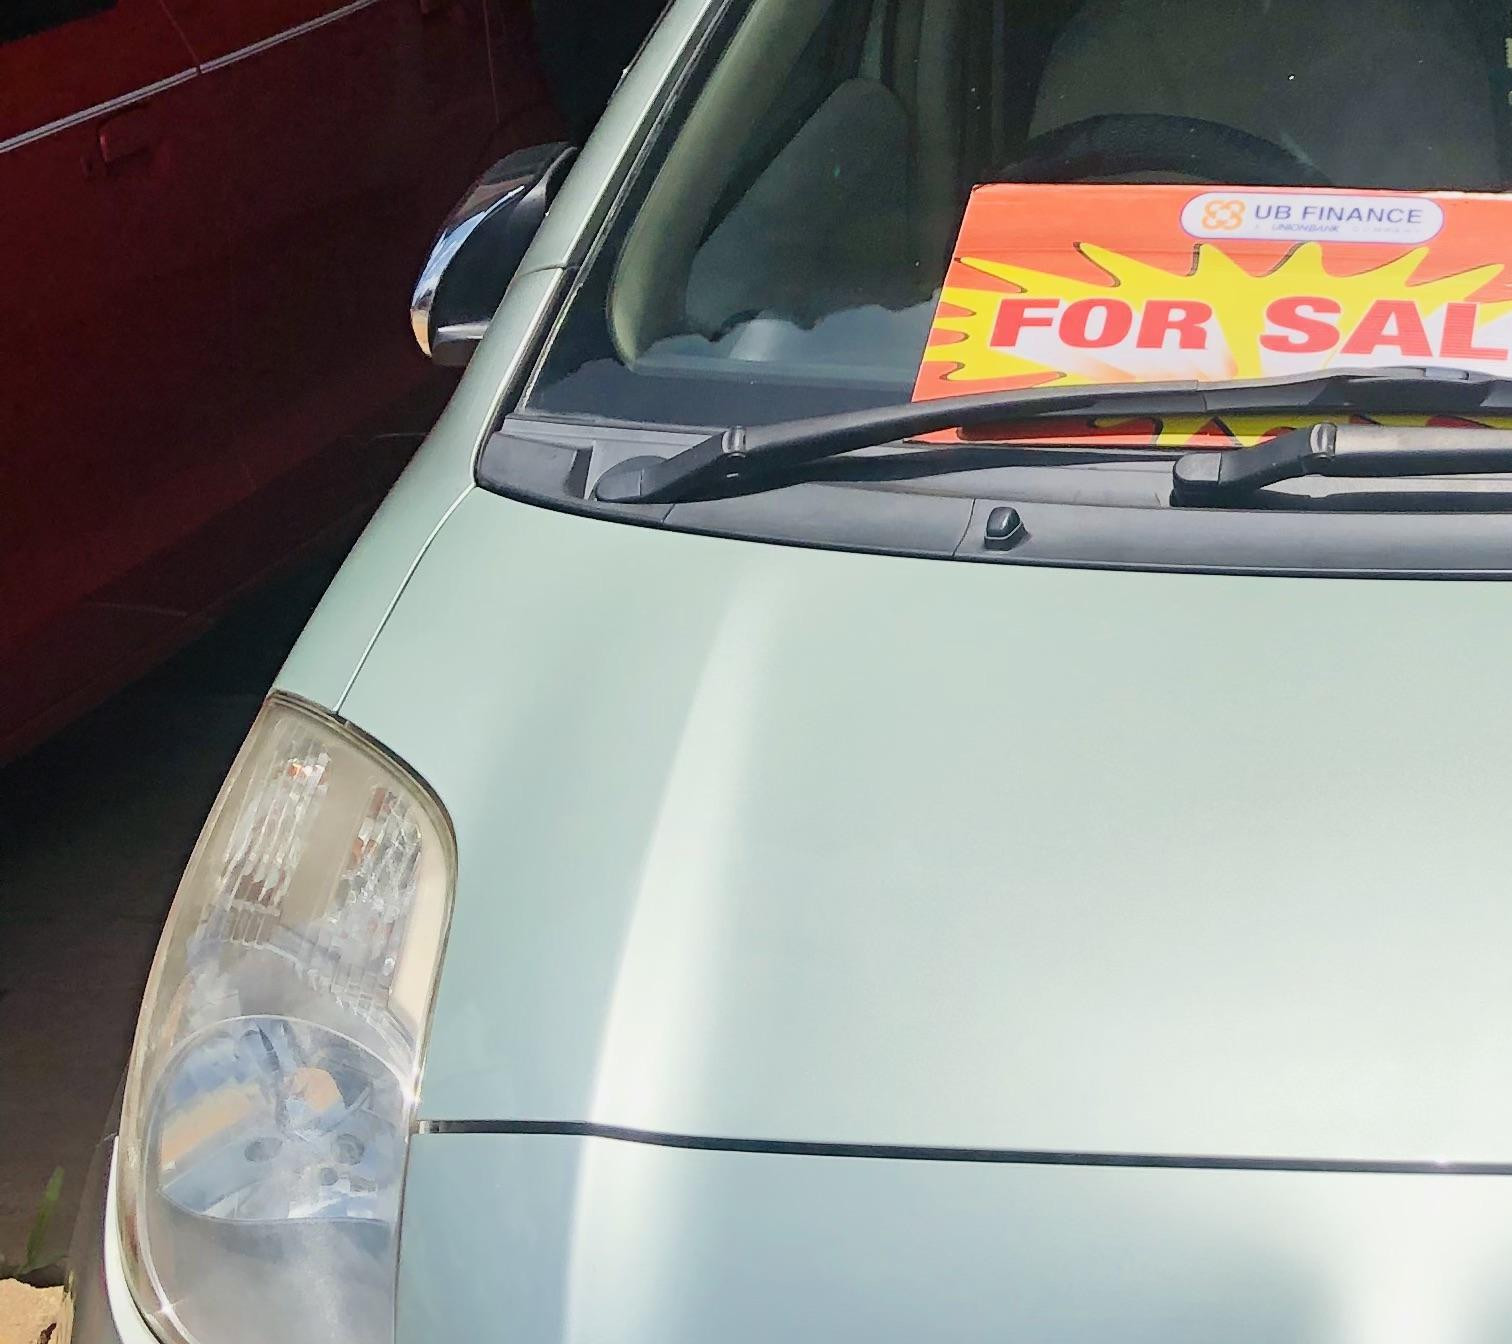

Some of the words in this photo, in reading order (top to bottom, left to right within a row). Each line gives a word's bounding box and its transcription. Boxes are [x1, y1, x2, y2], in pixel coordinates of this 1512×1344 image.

[1254, 204, 1292, 220] UB
[1301, 205, 1423, 224] FINANCE
[989, 298, 1213, 350] FOR
